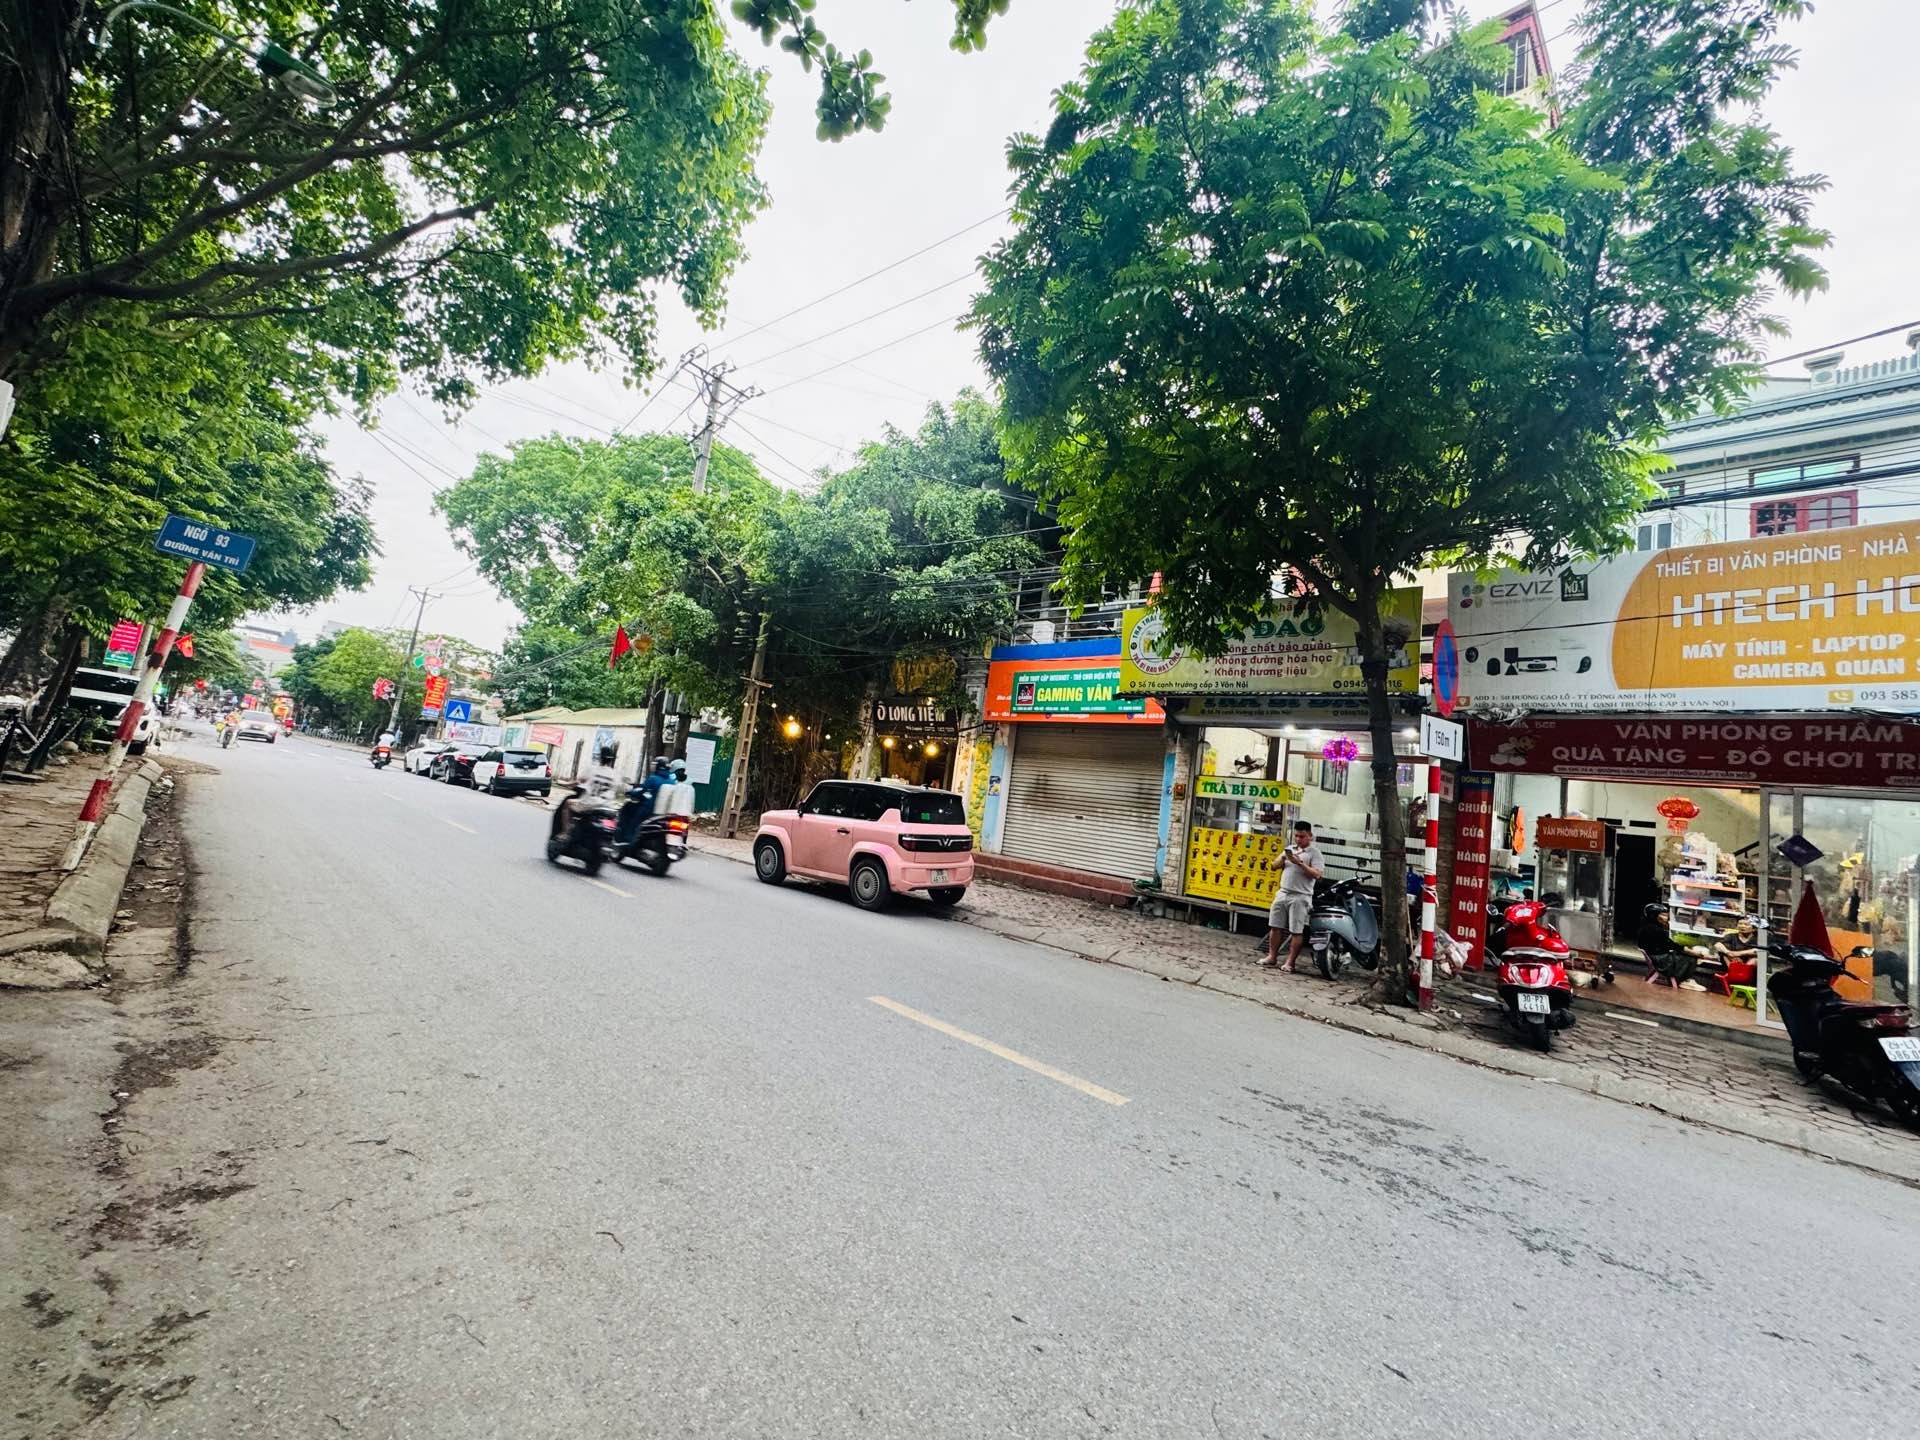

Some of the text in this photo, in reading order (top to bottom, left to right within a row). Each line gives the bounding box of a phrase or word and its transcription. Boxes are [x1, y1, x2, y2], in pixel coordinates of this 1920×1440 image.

[215, 534, 230, 548] 93
[1656, 553, 1702, 578] THIẾT
[1707, 557, 1724, 577] BỊ
[1730, 549, 1767, 571] VĂN
[1773, 543, 1842, 567] PHÒNG
[1863, 532, 1909, 558] NHÀ
[1490, 580, 1554, 598] EZVIZ
[1672, 581, 1835, 629] HTECH
[1251, 642, 1277, 653] chất
[1682, 639, 1726, 660] MÁY
[1735, 637, 1786, 657] TÍNH
[1812, 634, 1906, 654] LAPTOP
[1214, 654, 1248, 667] Không
[1311, 653, 1333, 665] học
[1214, 667, 1247, 678] Không
[1286, 666, 1308, 678] liệu
[1733, 661, 1826, 680] CAMERA
[1835, 658, 1905, 676] QUAN
[1036, 687, 1083, 702] GAMING
[1086, 683, 1112, 701] VÂN
[1148, 681, 1156, 689] 76
[1860, 690, 1918, 701] 093 585
[877, 701, 886, 721] Ô
[888, 706, 916, 721] LONG
[1616, 719, 1904, 742] VĂN PHÒNG PHẨM
[1435, 730, 1450, 747] 150m
[1551, 744, 1606, 763] QUÀ
[1612, 745, 1687, 766] TẶNG
[1726, 745, 1772, 766] ĐỒ
[1783, 750, 1864, 769] CHƠI
[1876, 752, 1920, 770] TR
[1201, 780, 1228, 795] TRÀ
[1231, 781, 1246, 796] BÍ
[1248, 786, 1281, 799] ĐAO
[1457, 800, 1491, 815] CHUỖI
[1462, 825, 1485, 839] CỬA
[1456, 850, 1487, 864] HÀNG
[1455, 875, 1485, 890] NHẬT
[1458, 900, 1478, 914] NỘI
[1457, 925, 1477, 939] ĐỊA
